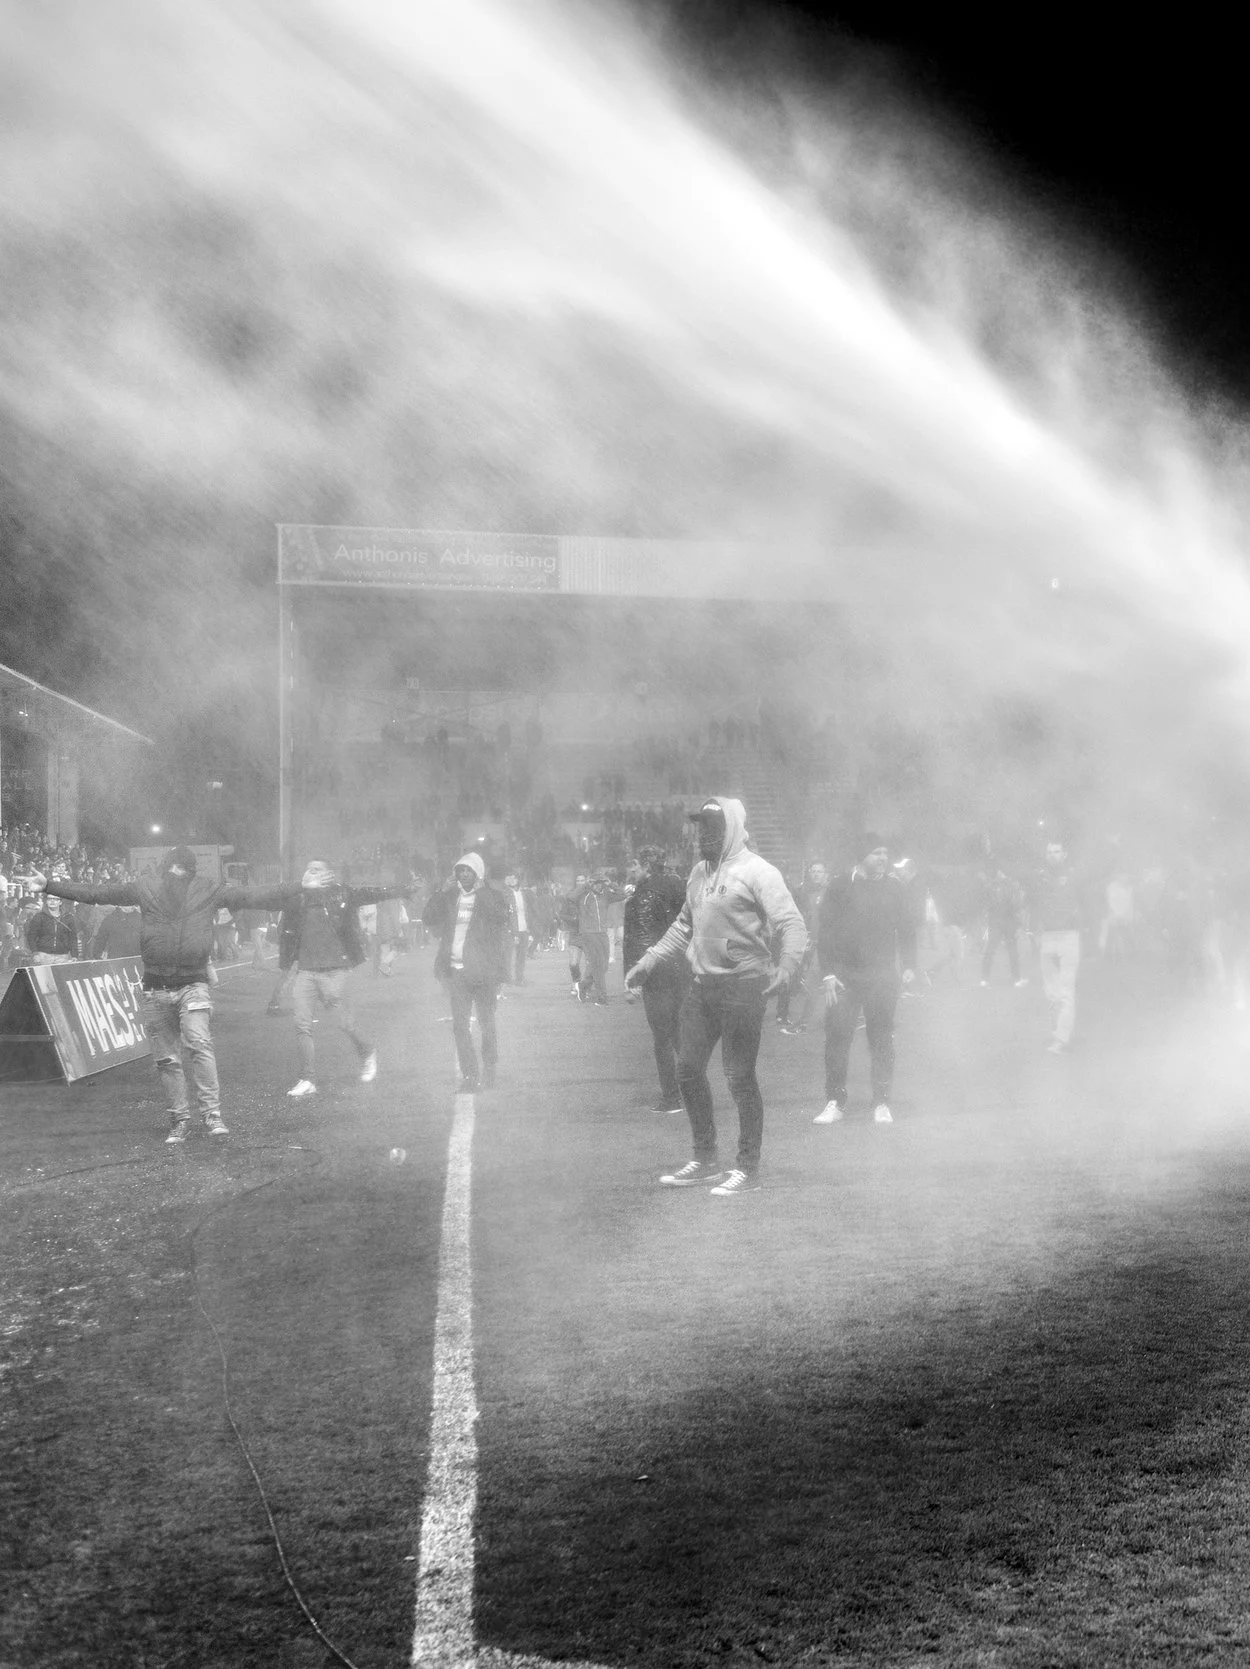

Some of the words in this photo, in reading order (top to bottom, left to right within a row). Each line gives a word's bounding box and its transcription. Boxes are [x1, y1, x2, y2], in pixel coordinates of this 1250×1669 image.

[333, 543, 429, 564] Anthonis
[439, 547, 557, 573] Advertising
[65, 973, 135, 1056] MAES
